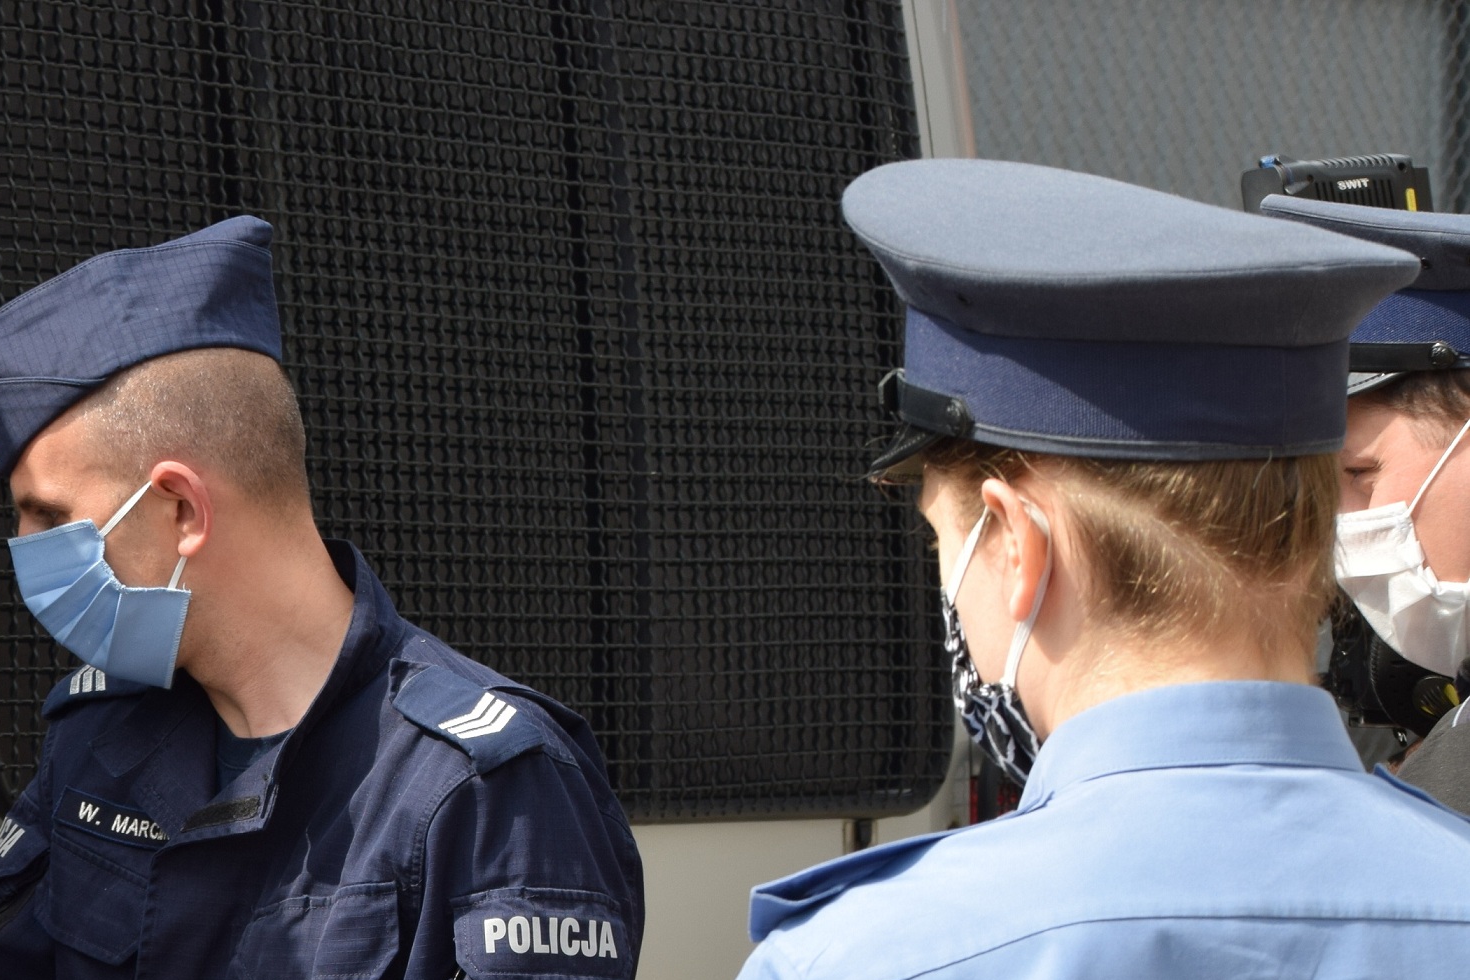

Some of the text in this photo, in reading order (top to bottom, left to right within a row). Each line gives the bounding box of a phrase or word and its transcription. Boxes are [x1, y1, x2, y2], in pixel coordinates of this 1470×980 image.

[1336, 177, 1370, 191] SWIT
[77, 801, 101, 826] W.
[484, 916, 618, 959] POLICJA
